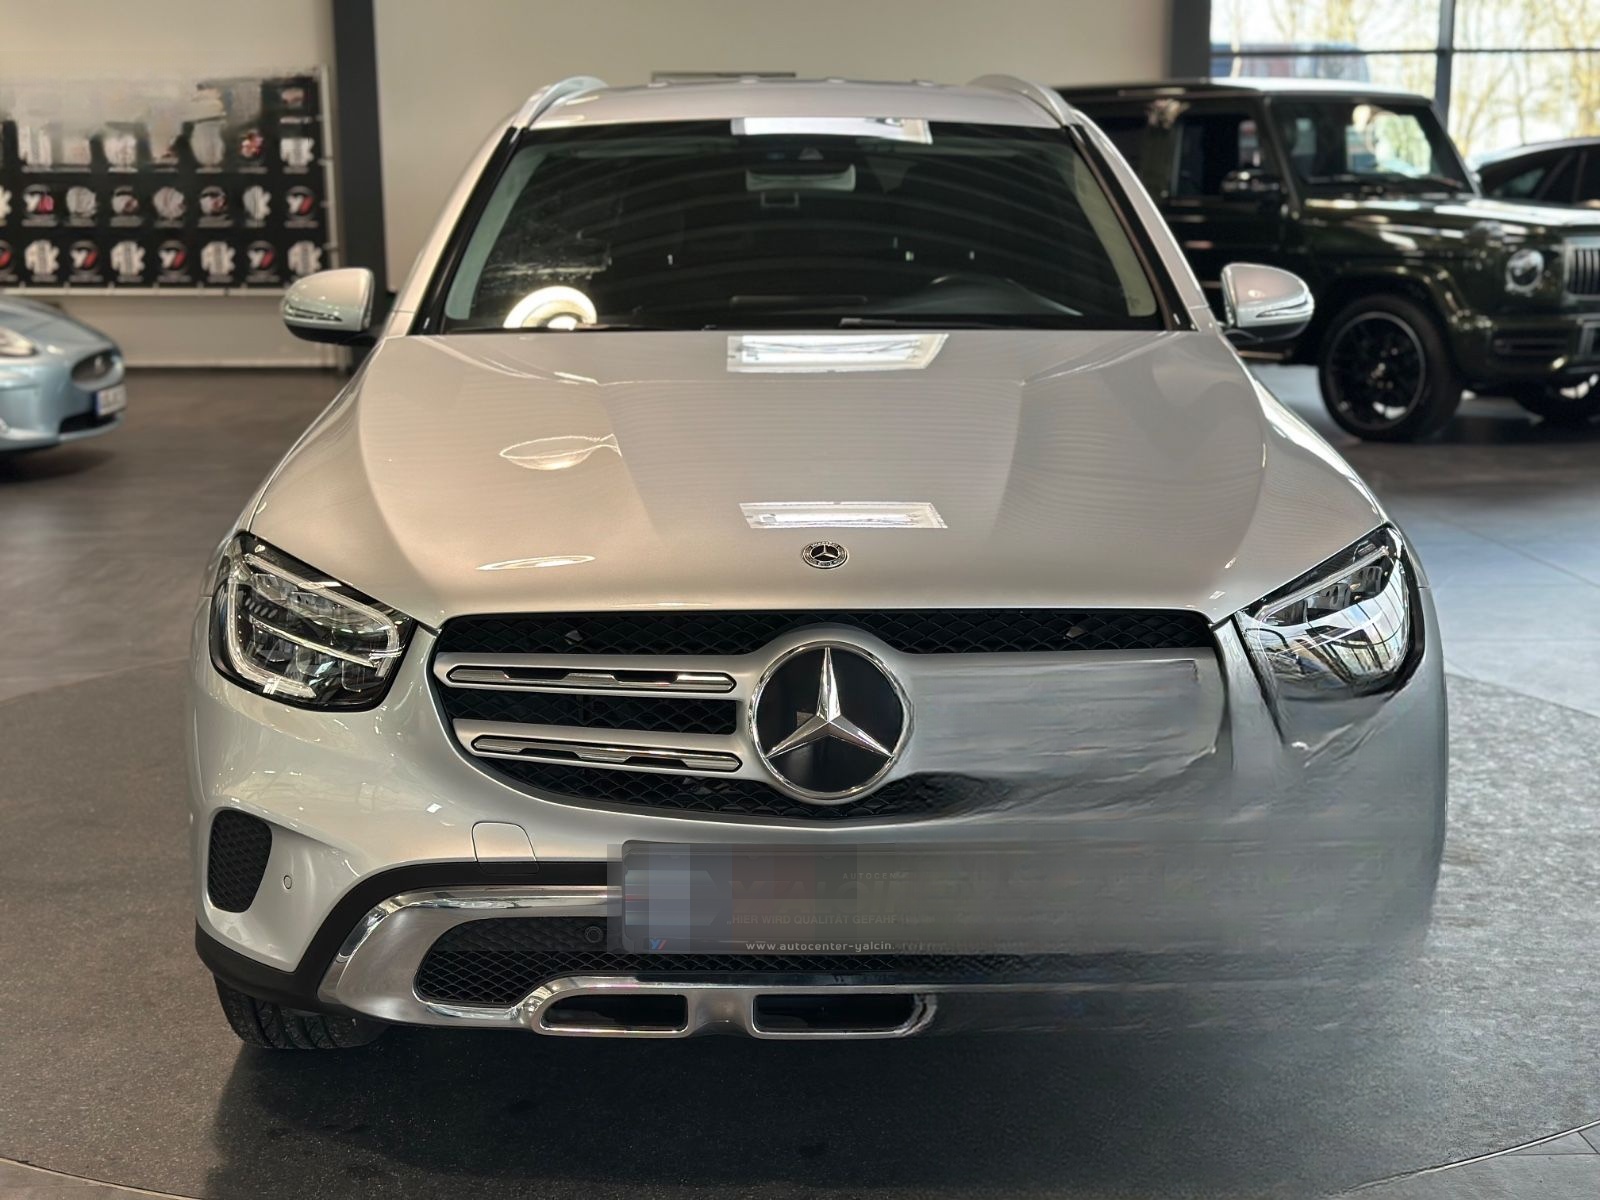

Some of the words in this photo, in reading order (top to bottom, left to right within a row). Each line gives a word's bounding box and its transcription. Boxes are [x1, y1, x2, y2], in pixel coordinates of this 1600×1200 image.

[843, 872, 897, 880] AUTOCEN
[761, 915, 791, 925] WIRD
[794, 914, 849, 925] QUALITÄT
[745, 941, 896, 953] www.autocenter-yalcin.
